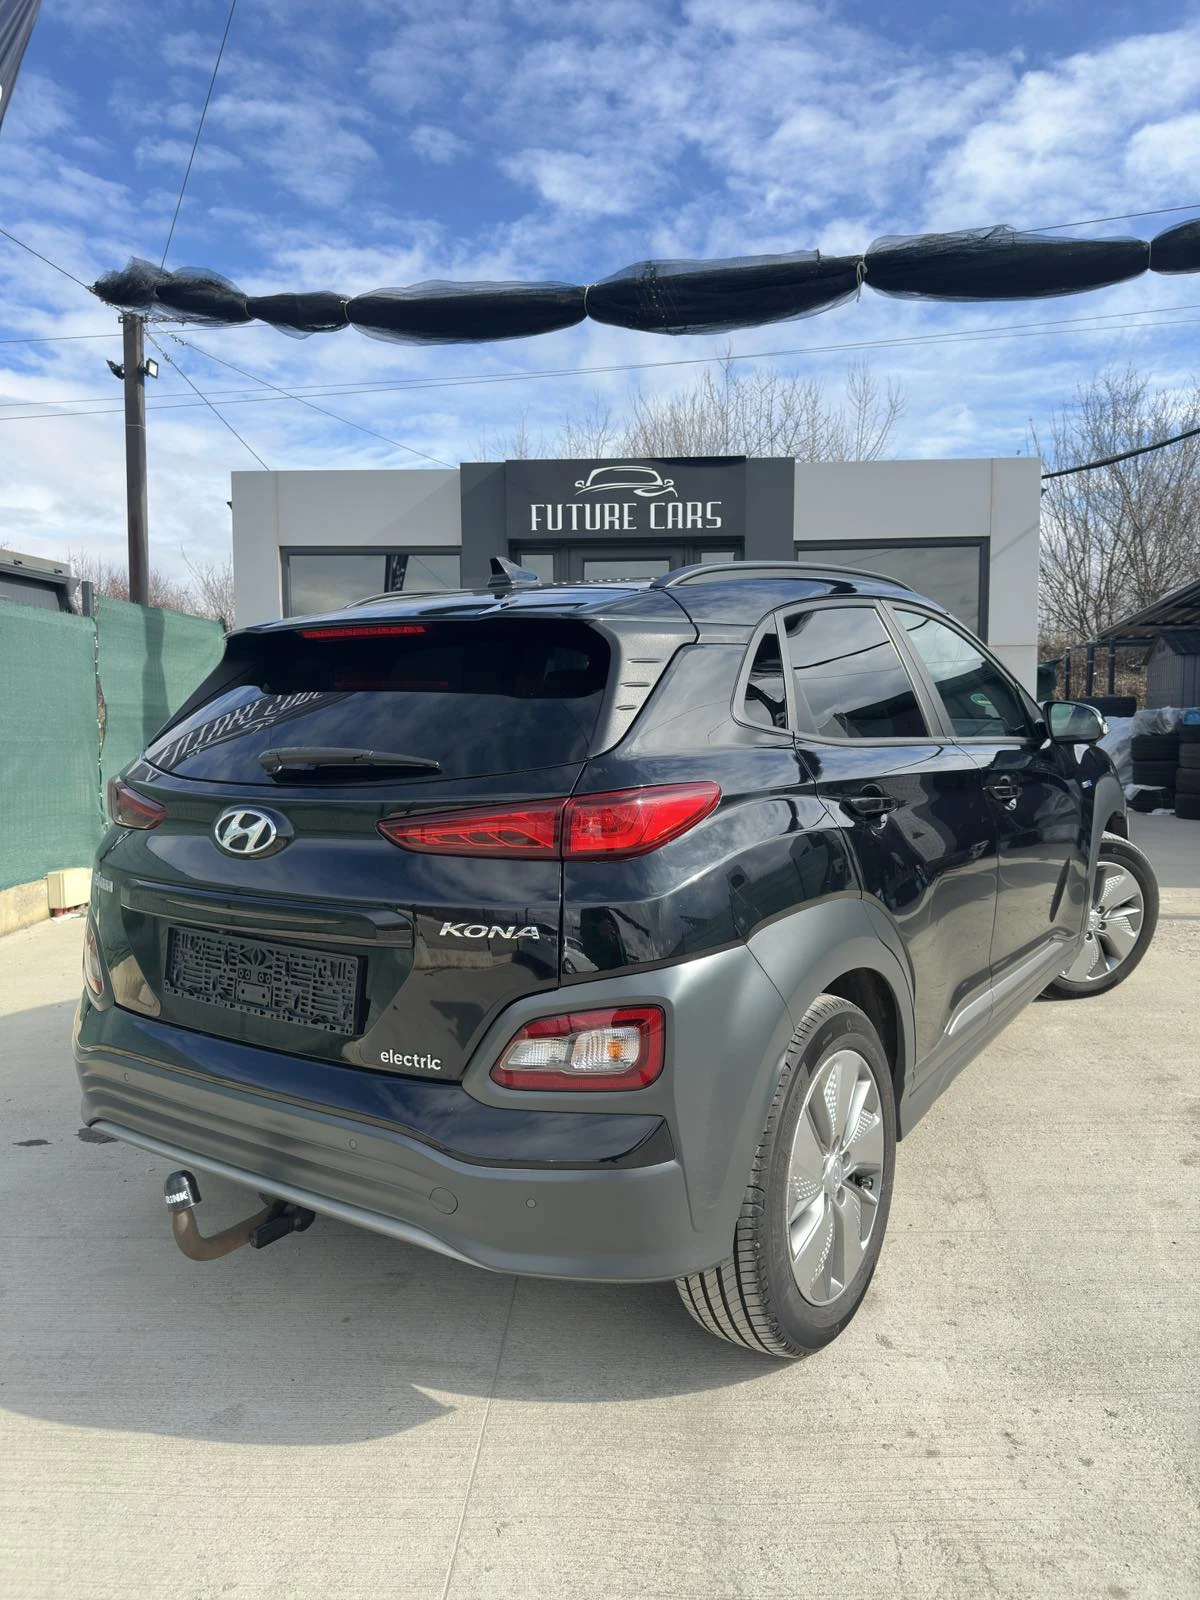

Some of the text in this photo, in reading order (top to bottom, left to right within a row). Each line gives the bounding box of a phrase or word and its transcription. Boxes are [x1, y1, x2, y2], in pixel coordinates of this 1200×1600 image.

[530, 501, 722, 531] FUTURE CARS
[439, 922, 540, 940] KONA
[380, 1049, 441, 1070] electric
